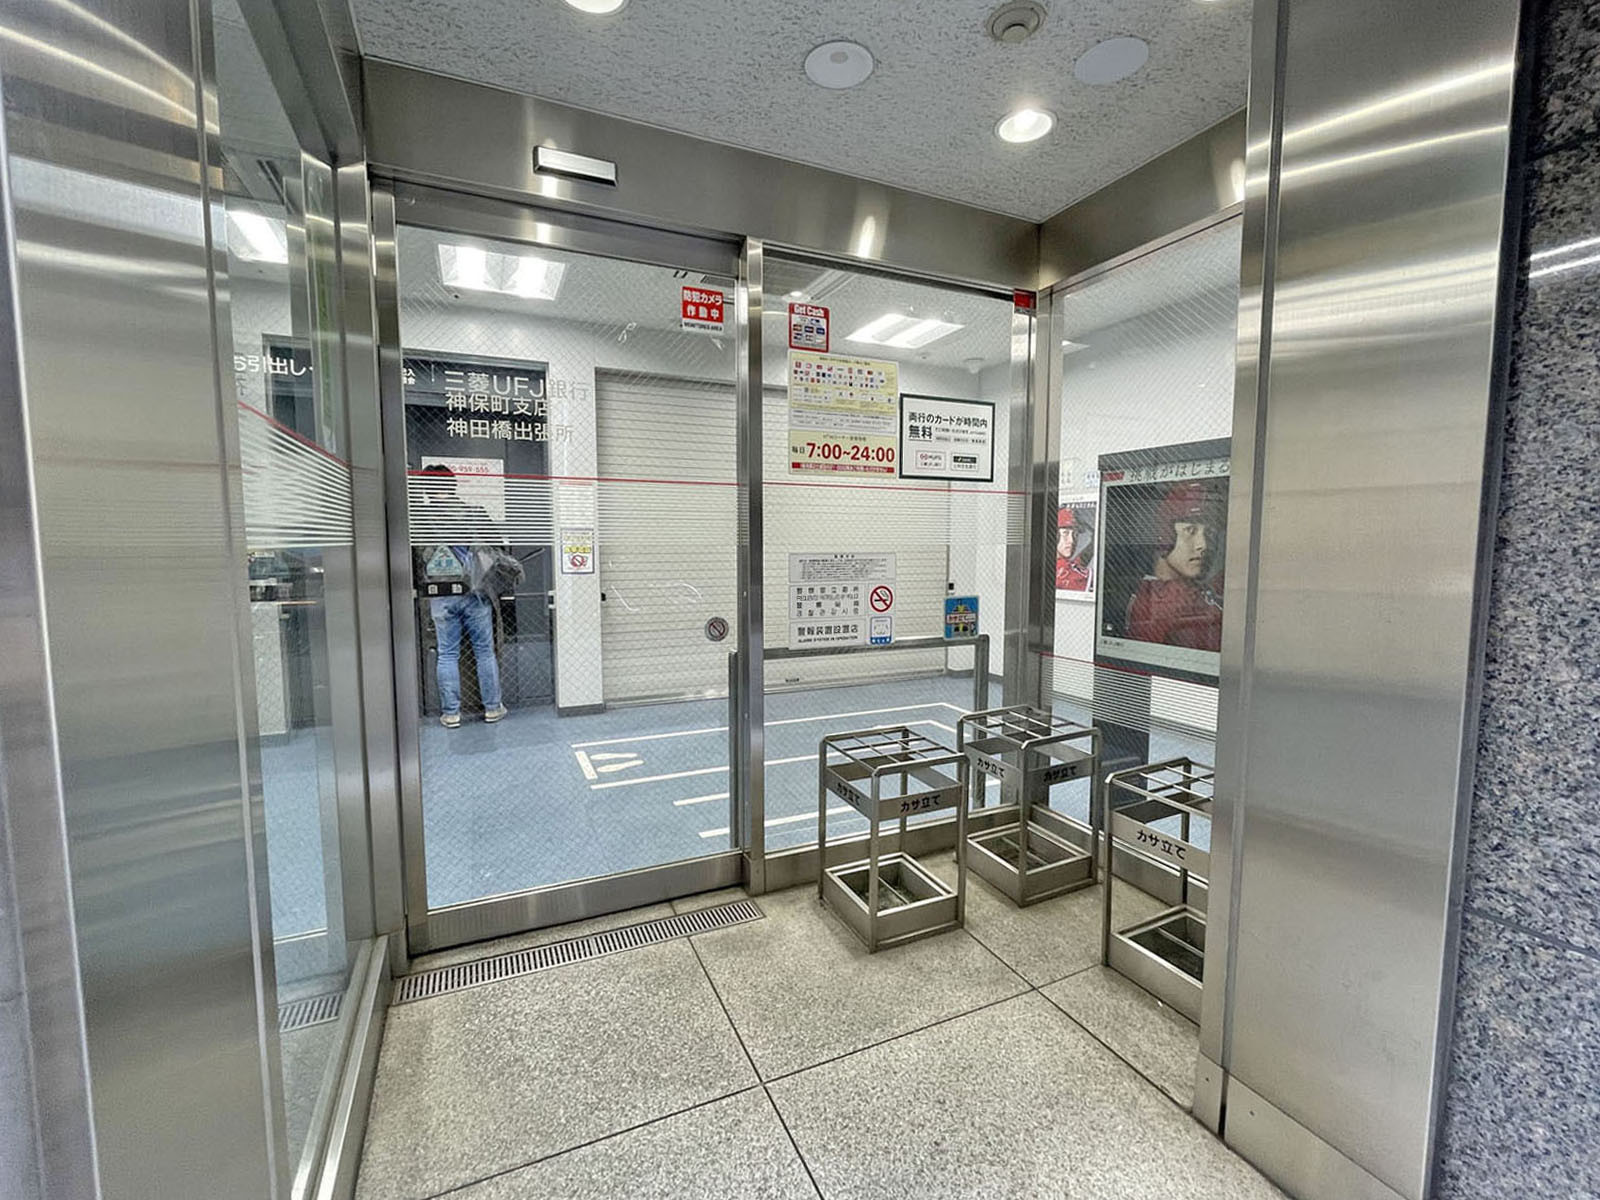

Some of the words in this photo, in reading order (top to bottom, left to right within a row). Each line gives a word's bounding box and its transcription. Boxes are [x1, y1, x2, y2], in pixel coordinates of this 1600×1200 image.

[683, 290, 723, 305] 防犯カメラ
[687, 304, 719, 319] 作動中
[444, 370, 591, 401] 三菱UFJ銀行
[445, 391, 554, 417] 神保町支店
[446, 417, 573, 442] 神田橋出張所
[908, 425, 933, 440] 無料
[977, 758, 1005, 778] カサ立て
[1043, 765, 1077, 782] カサ立て
[900, 795, 941, 813] カサ立て
[1136, 829, 1186, 860] カサ立て
